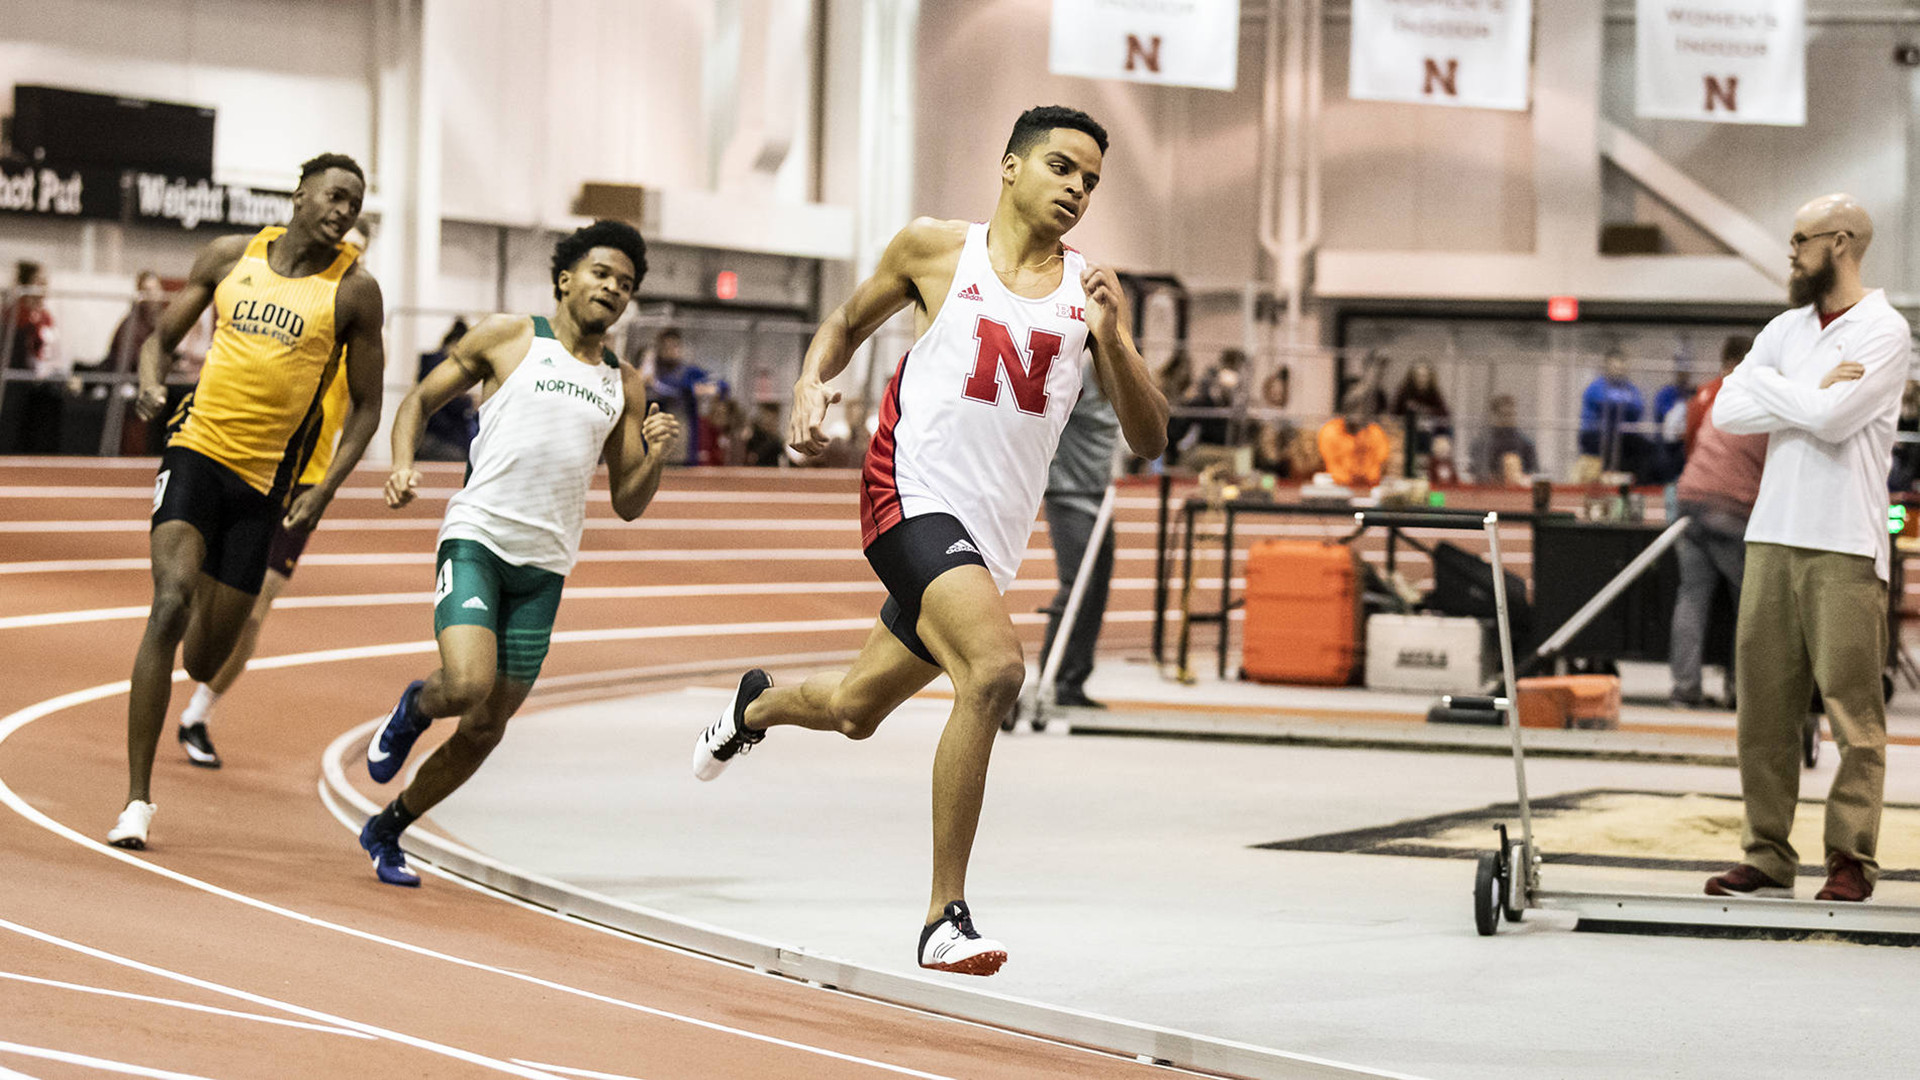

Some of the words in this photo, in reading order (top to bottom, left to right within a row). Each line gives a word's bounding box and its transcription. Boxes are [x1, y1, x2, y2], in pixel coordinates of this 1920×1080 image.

[1124, 33, 1161, 73] N
[1423, 57, 1458, 95] N
[1703, 75, 1738, 112] N
[37, 168, 83, 215] Put
[138, 171, 224, 230] Weight
[232, 300, 305, 338] CLOUD
[961, 314, 1066, 418] N
[534, 379, 617, 423] NORTHWEST
